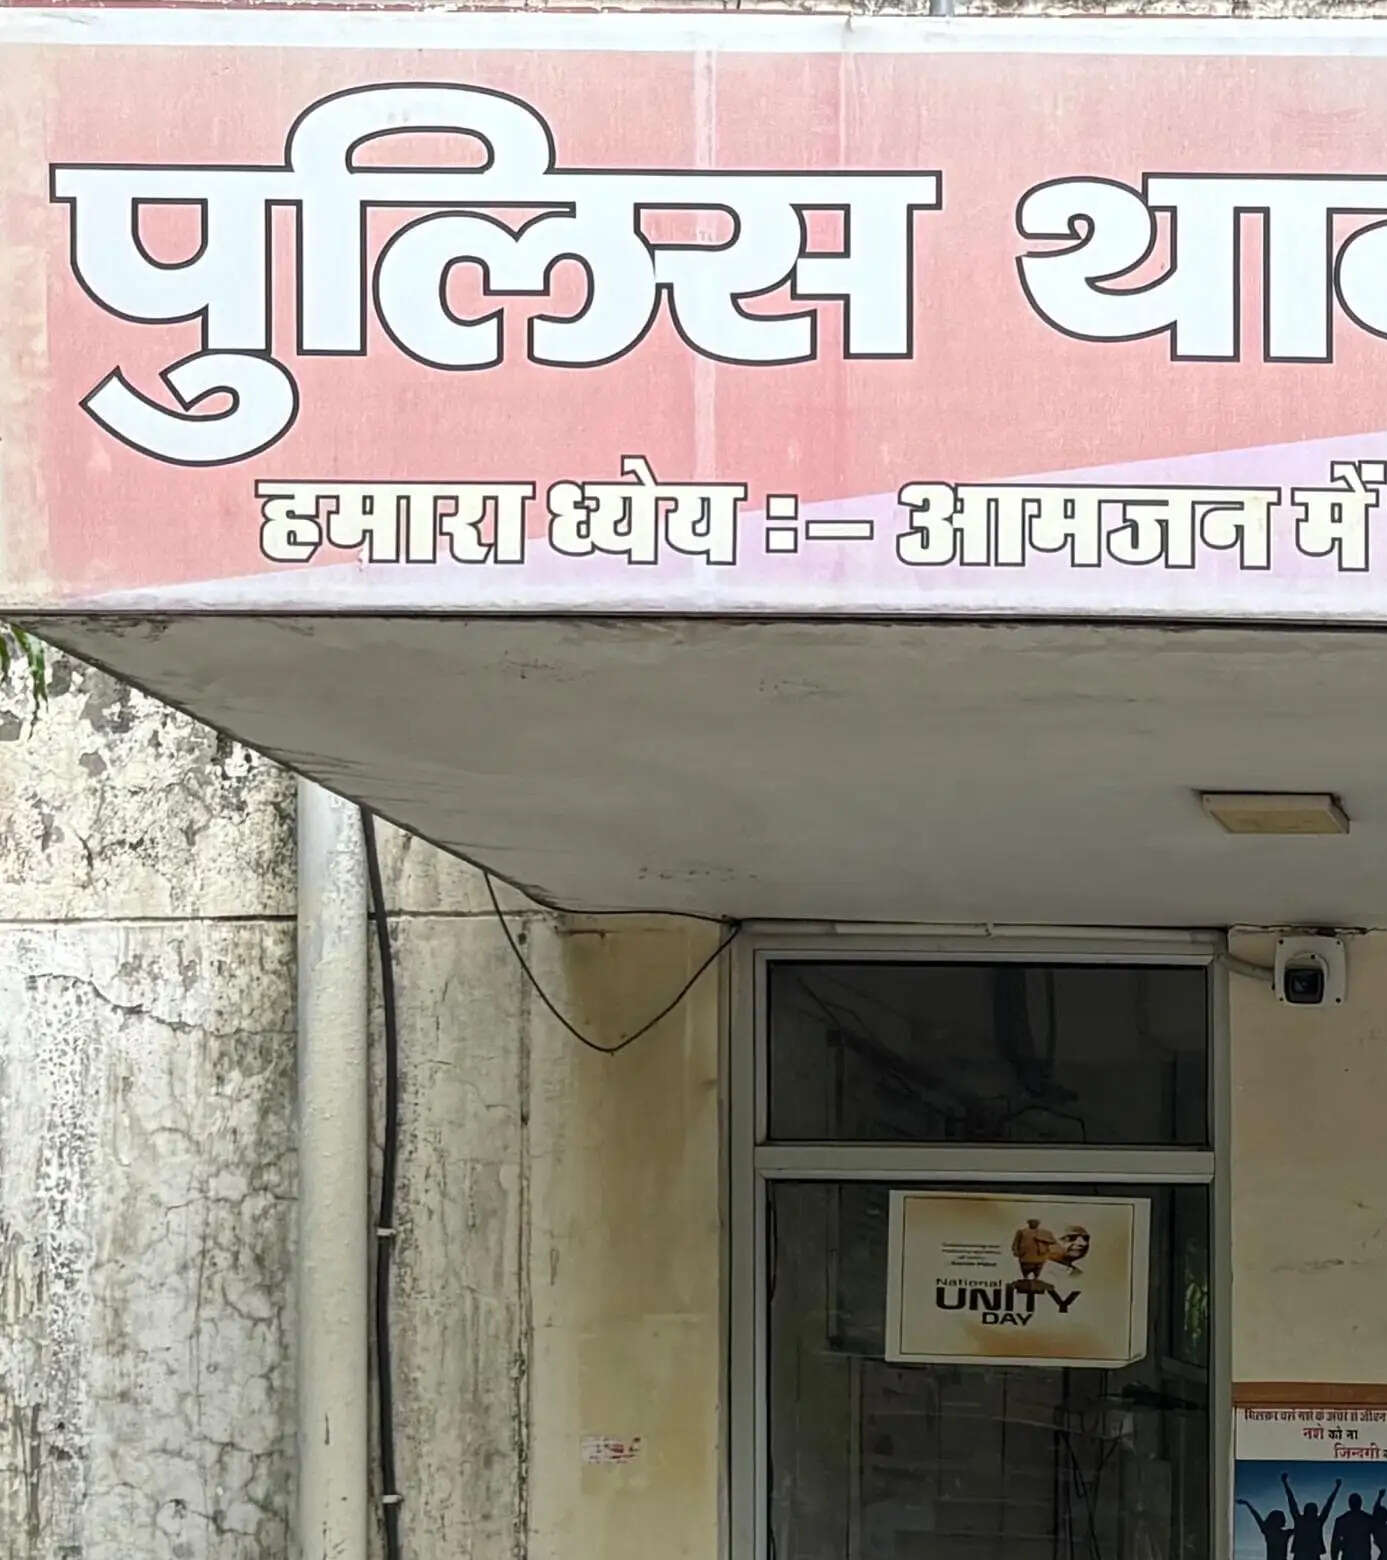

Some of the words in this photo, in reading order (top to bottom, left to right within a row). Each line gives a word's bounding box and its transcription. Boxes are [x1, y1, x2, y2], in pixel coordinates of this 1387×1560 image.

[47, 80, 944, 468] पुलिस
[253, 477, 536, 565] हमारा
[548, 454, 746, 565] ध्येय
[897, 479, 1281, 572] आमजन
[1293, 460, 1386, 573] में
[936, 1287, 1081, 1314] UNITY
[982, 1312, 1032, 1326] DAY
[1303, 1424, 1324, 1440] नशे
[1329, 1426, 1343, 1440] को
[1346, 1431, 1358, 1440] ना
